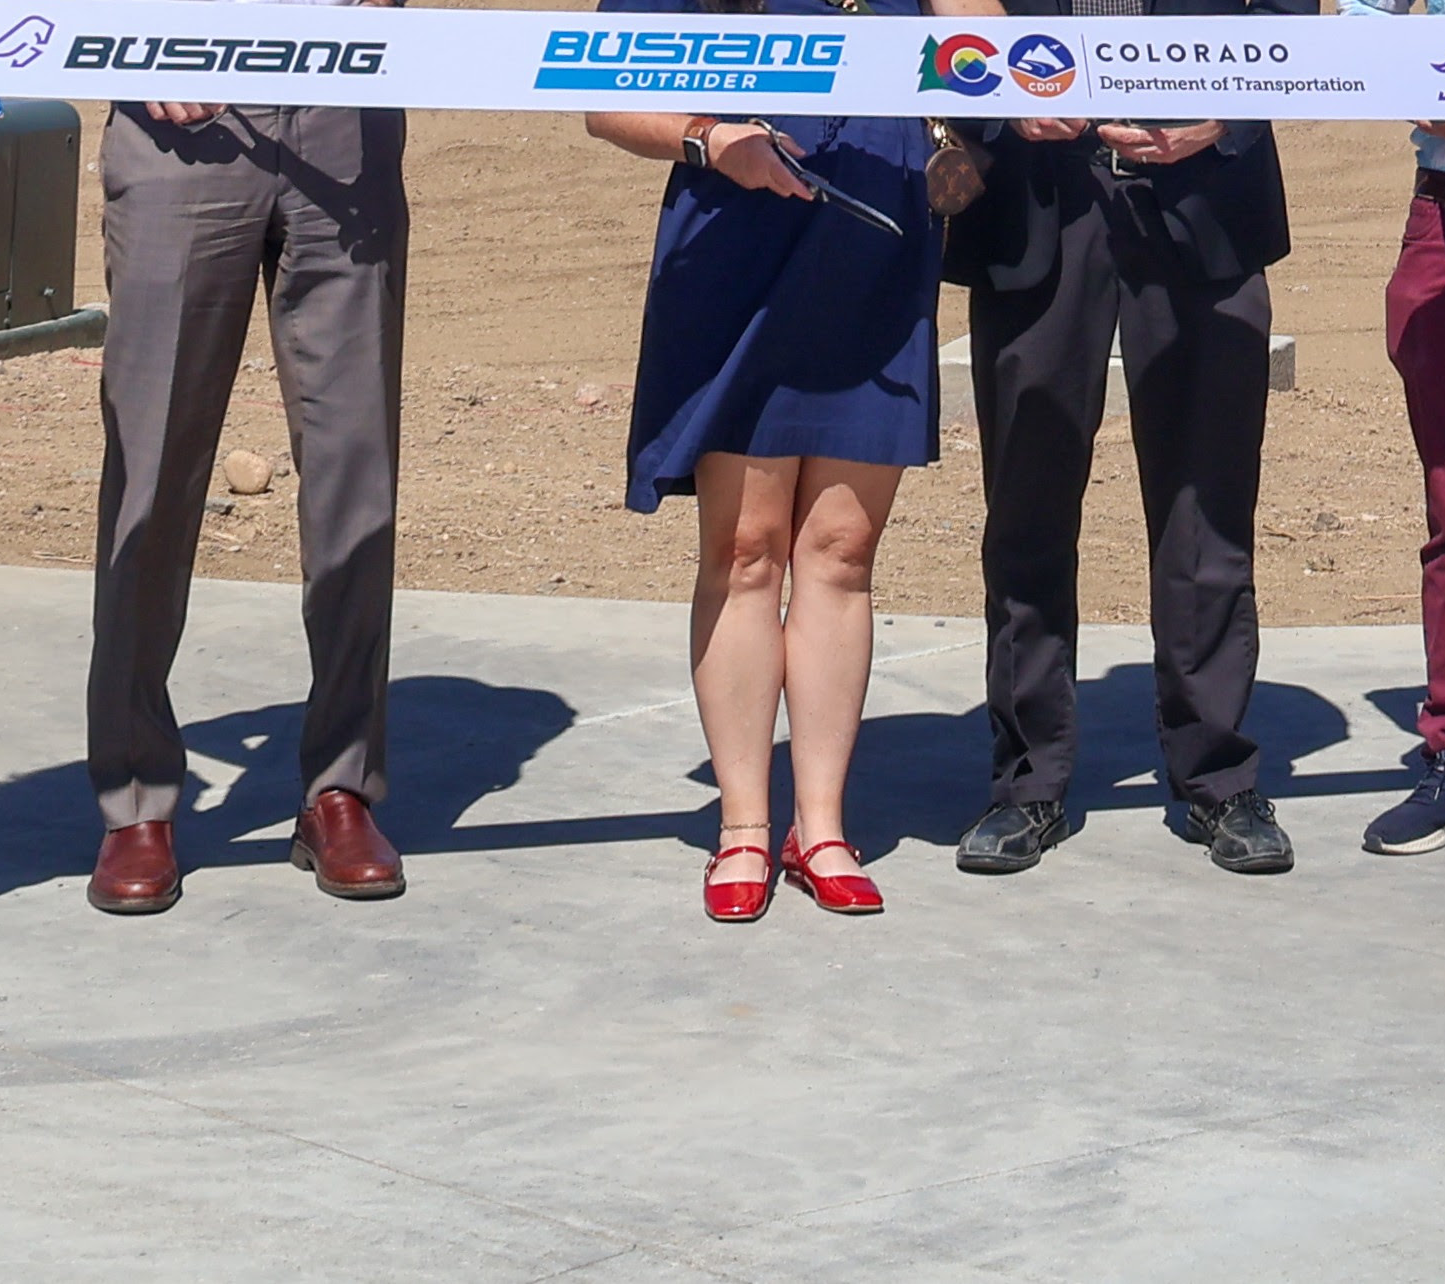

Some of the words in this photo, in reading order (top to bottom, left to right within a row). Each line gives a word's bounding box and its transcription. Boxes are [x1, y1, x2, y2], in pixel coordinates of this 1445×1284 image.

[1095, 43, 1289, 63] COLORADO
[615, 71, 758, 89] OUTRIDER
[1028, 82, 1062, 93] CDOT
[1099, 75, 1207, 93] Department
[1211, 76, 1230, 92] of
[1232, 76, 1366, 95] Transportation
